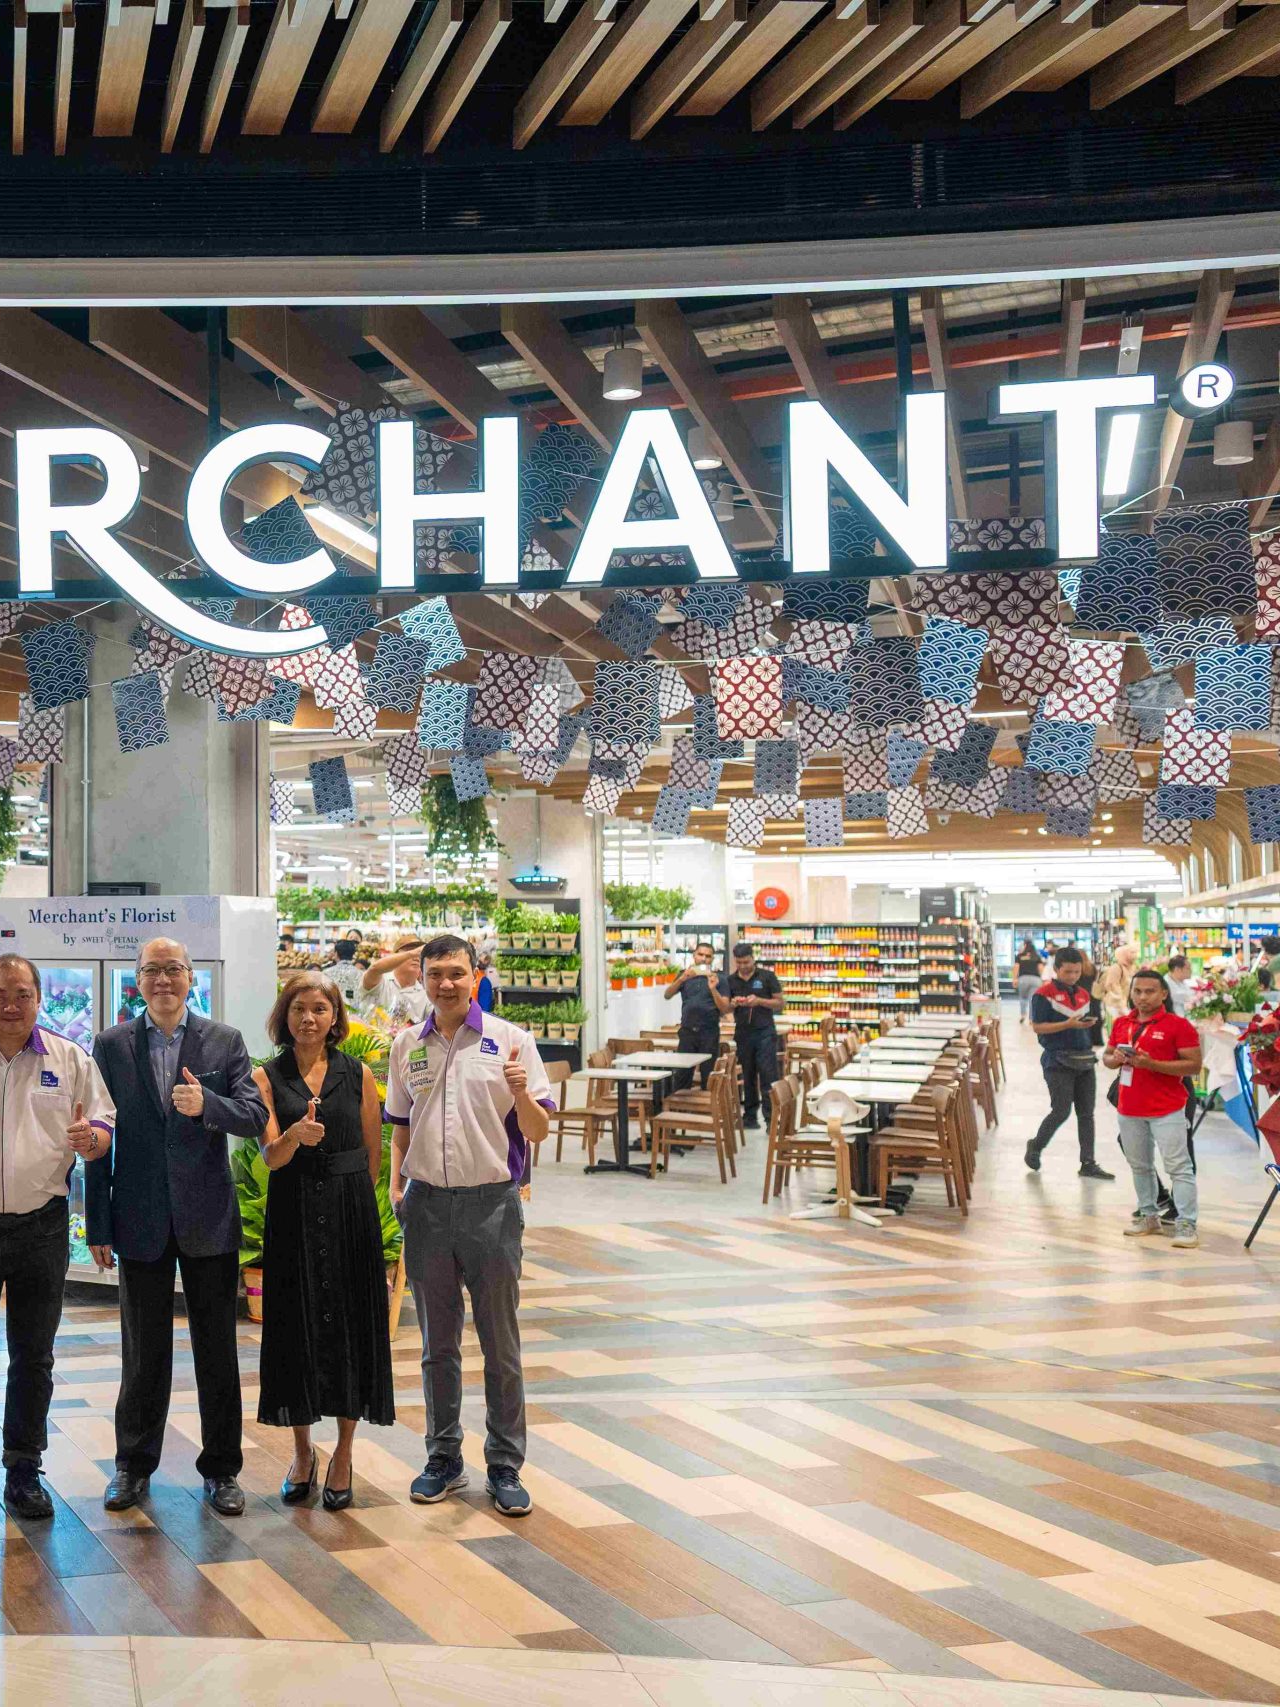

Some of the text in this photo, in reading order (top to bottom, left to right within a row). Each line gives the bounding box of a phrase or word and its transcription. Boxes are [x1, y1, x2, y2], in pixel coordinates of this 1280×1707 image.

[28, 907, 177, 924] Merchant's Florist
[63, 933, 139, 946] by SWEET PETALS
